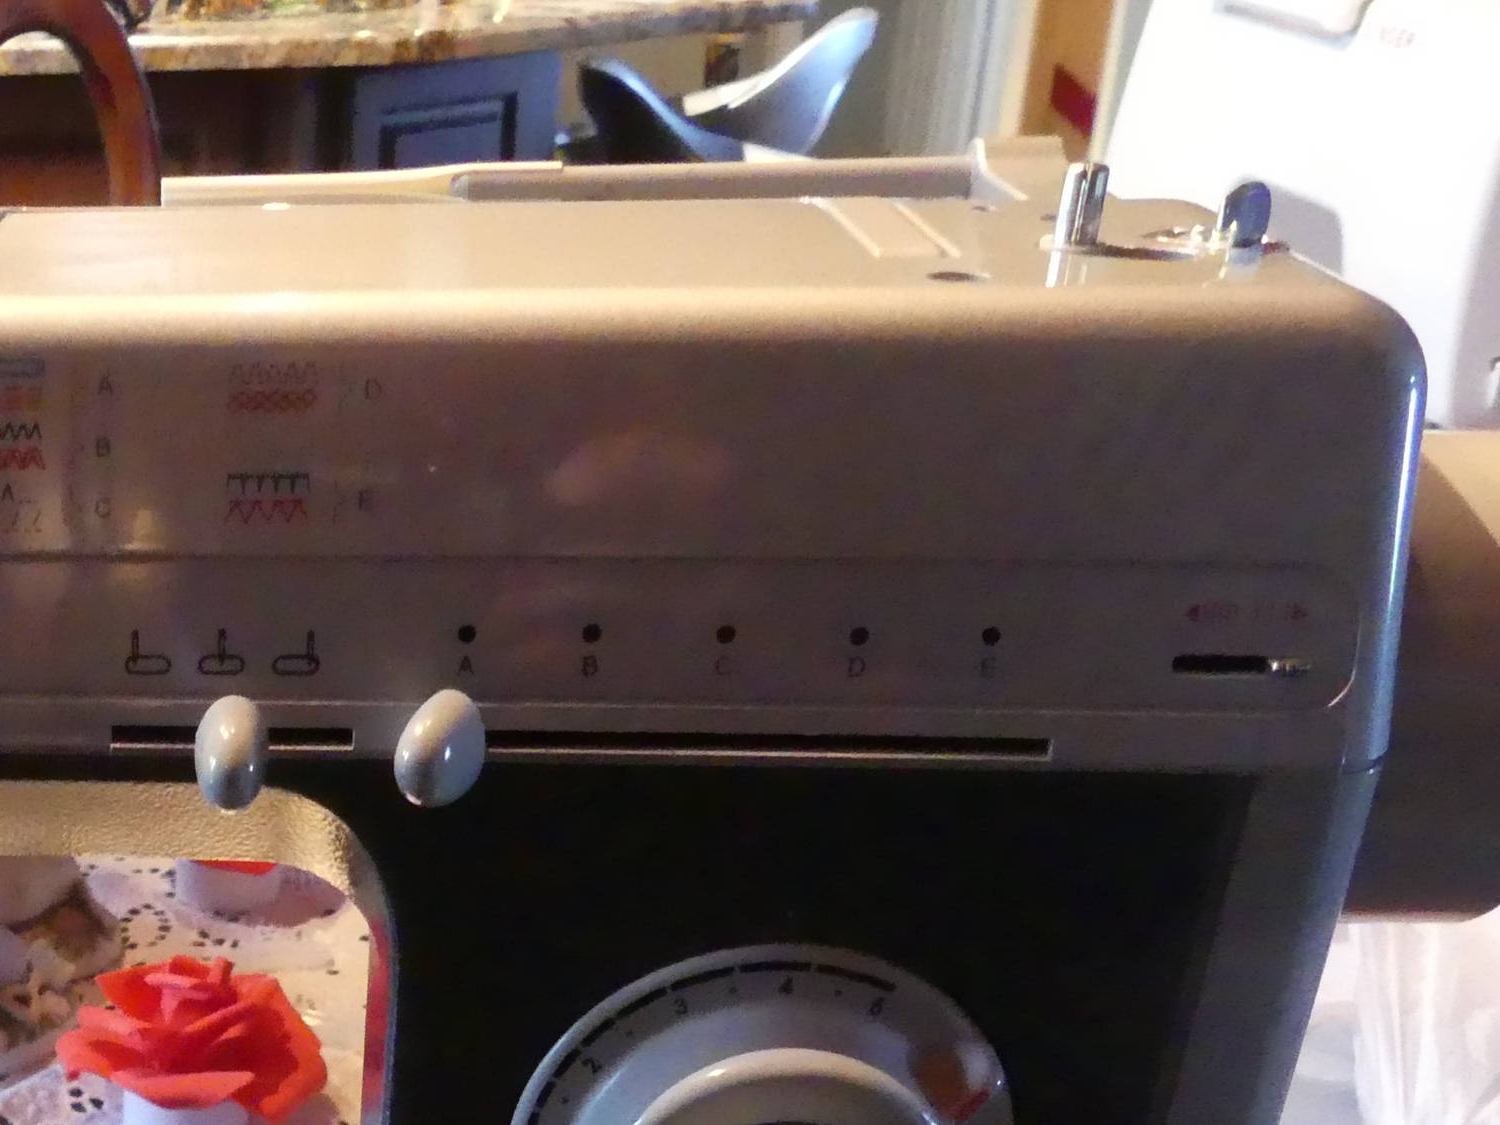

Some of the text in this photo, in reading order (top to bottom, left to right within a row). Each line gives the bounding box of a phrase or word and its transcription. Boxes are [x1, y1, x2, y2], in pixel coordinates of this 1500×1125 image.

[457, 655, 997, 679] A B C D E
[581, 1056, 603, 1076] 2
[778, 976, 794, 995] 4
